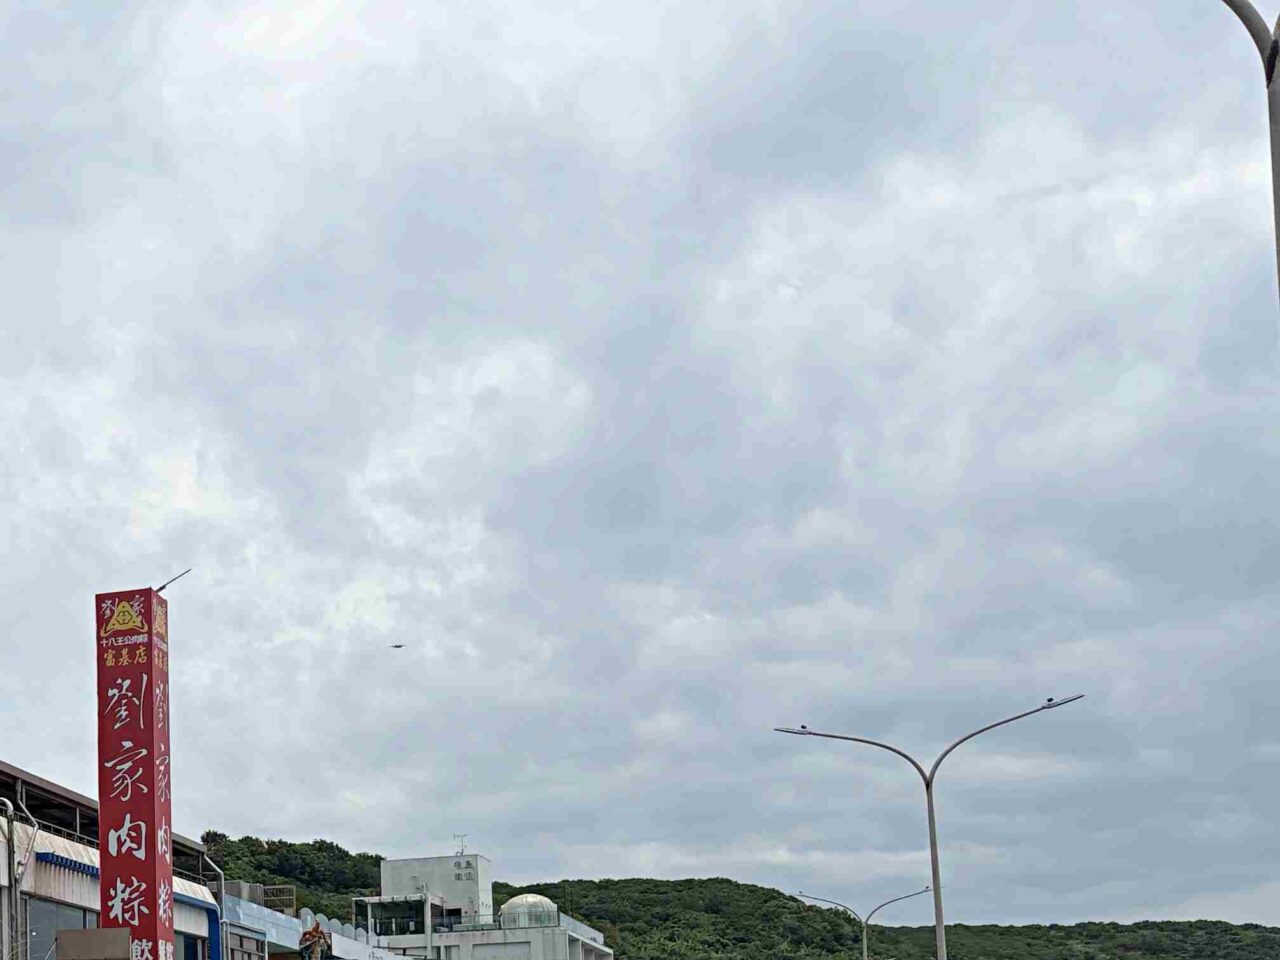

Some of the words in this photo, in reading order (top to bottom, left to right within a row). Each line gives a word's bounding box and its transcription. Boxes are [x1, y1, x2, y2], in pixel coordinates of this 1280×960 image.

[104, 645, 148, 667] 富基店
[104, 672, 150, 927] 劉家肉粽
